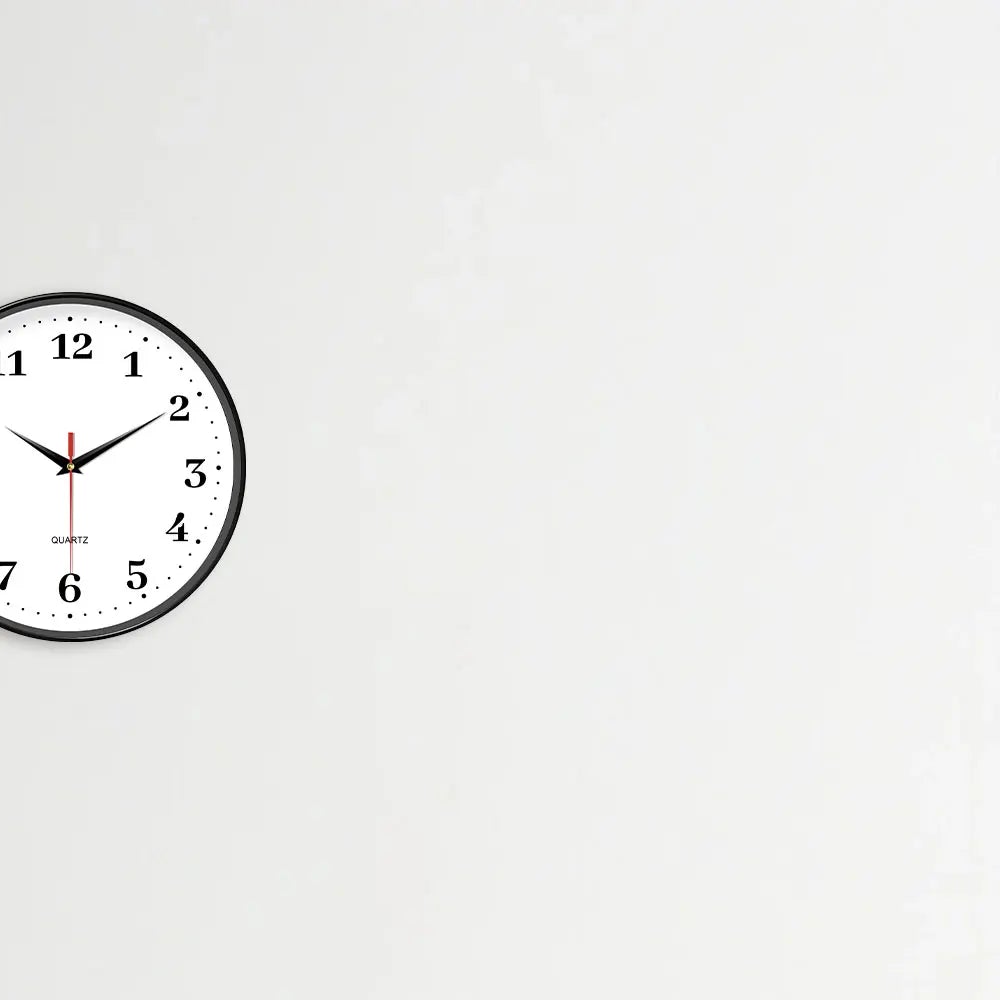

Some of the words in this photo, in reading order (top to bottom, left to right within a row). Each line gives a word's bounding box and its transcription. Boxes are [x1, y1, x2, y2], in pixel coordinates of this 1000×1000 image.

[51, 332, 93, 360] 12
[123, 351, 143, 378] 1
[169, 394, 190, 422] 2
[184, 458, 207, 489] 3
[51, 536, 89, 544] QUARTZ
[165, 512, 189, 542] 4
[58, 573, 82, 603] 6
[126, 558, 148, 590] 5
